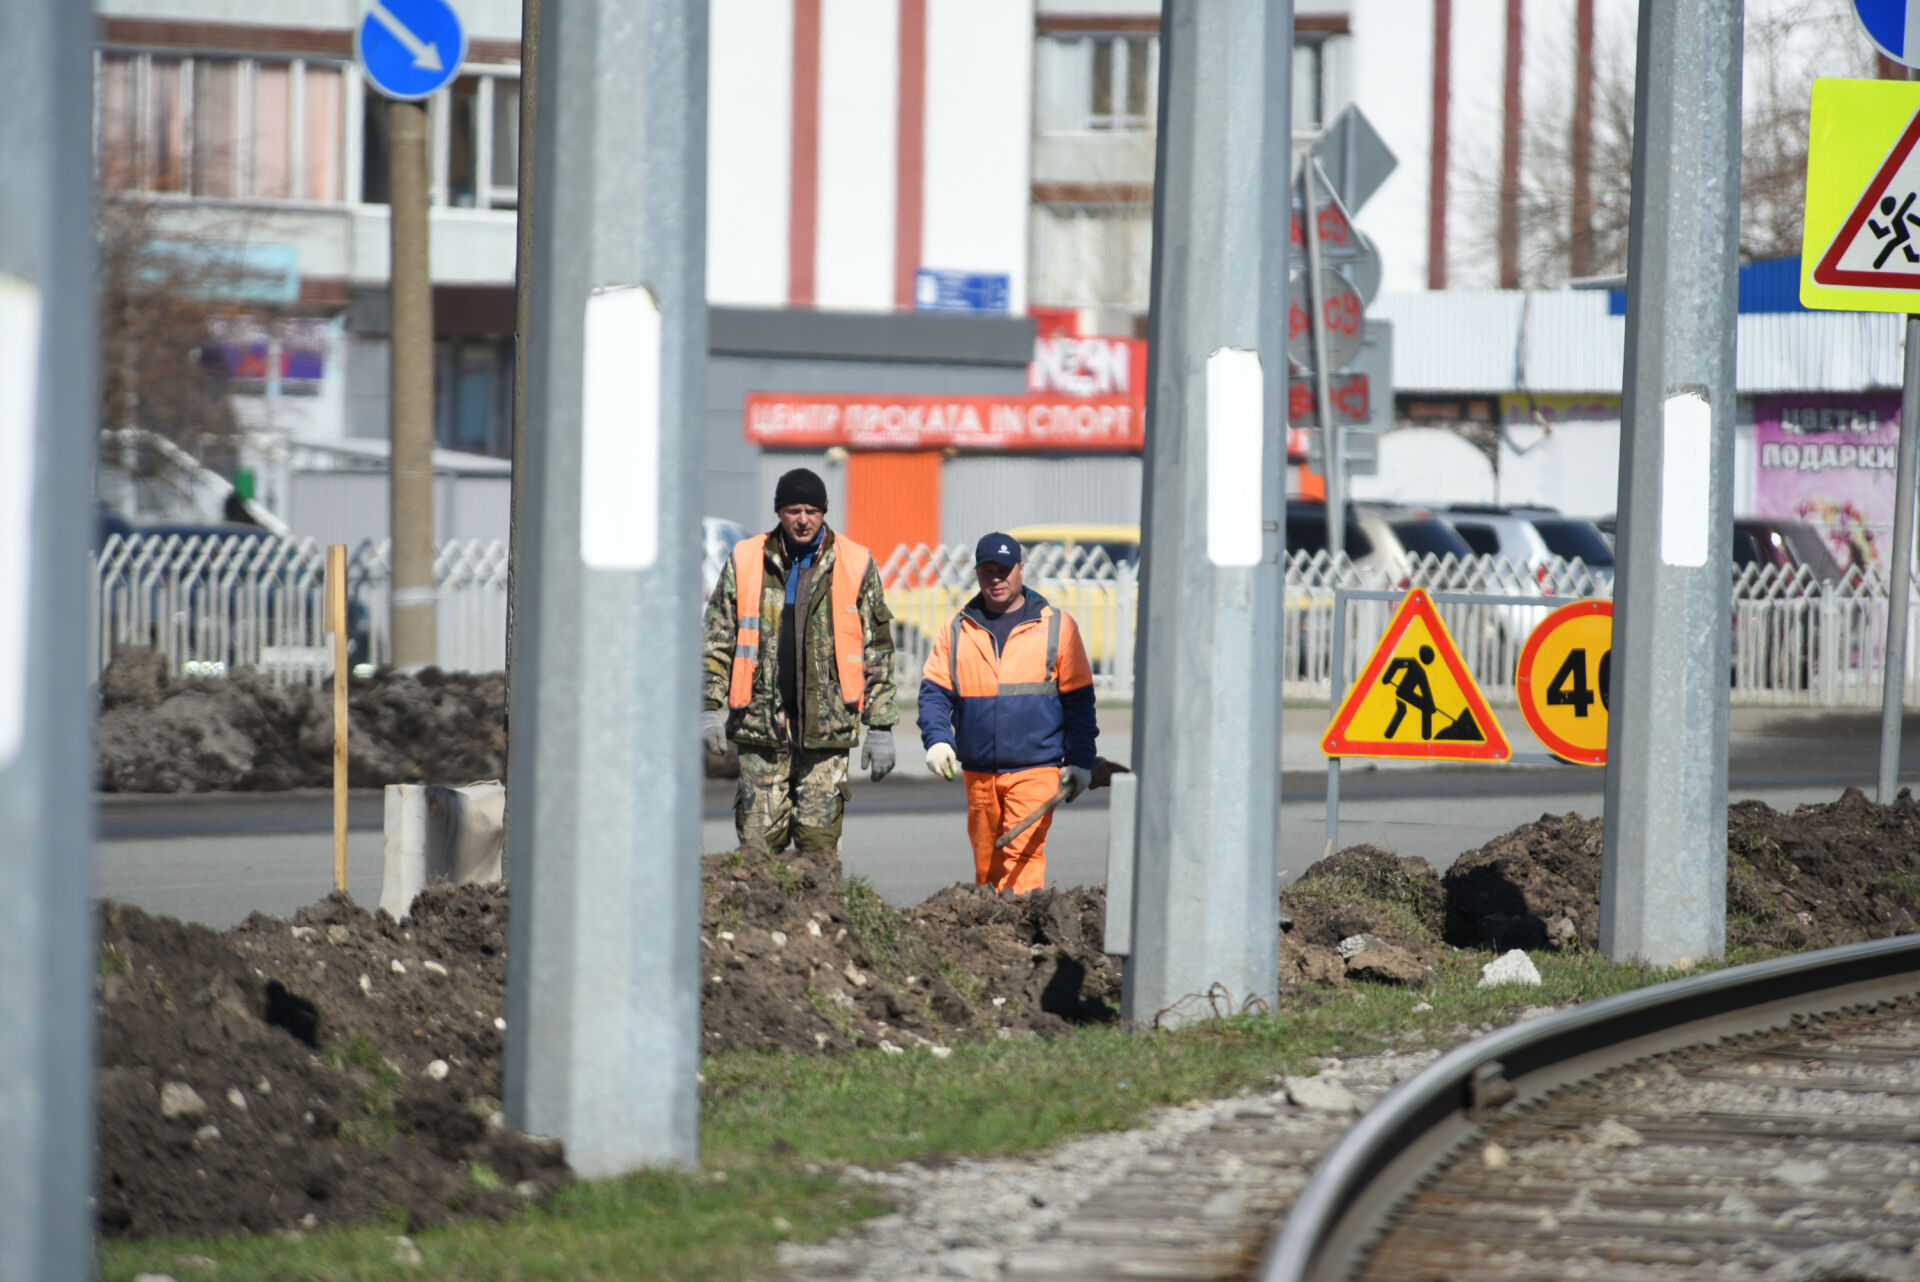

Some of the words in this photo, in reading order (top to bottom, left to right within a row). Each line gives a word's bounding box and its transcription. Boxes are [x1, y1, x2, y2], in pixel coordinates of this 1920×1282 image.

[750, 403, 841, 435] ЦЕНТР
[844, 404, 981, 436] ПРОКАТА
[1028, 405, 1134, 438] СПОРТ
[1781, 407, 1878, 434] ЦВЕТЫ
[1761, 443, 1896, 472] ПОДАРКИ
[1546, 648, 1611, 718] 4
